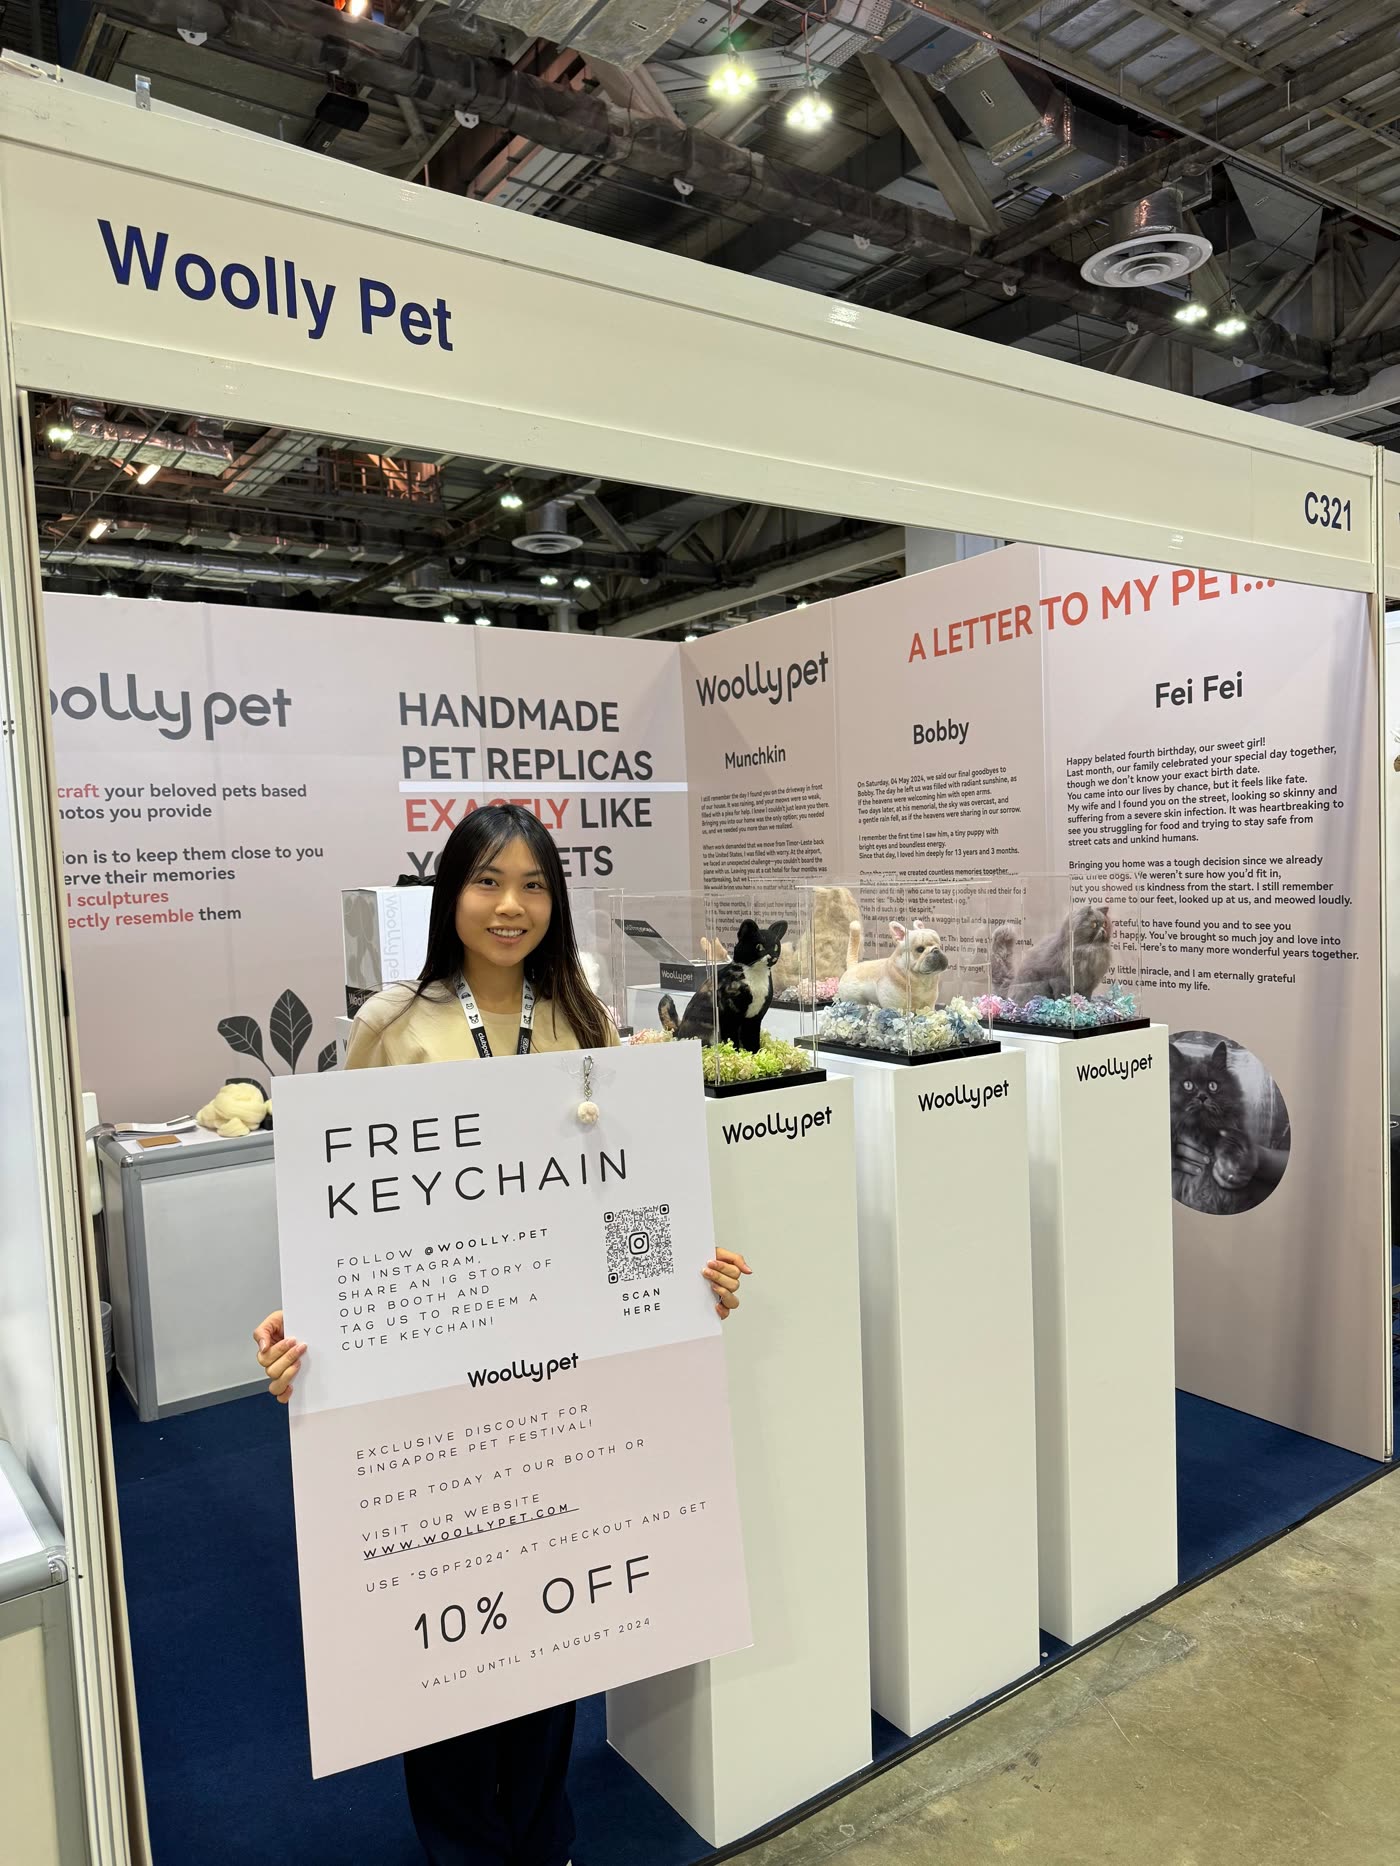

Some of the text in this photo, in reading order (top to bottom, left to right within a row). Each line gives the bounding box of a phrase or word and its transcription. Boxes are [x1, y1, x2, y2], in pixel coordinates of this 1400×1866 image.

[97, 218, 453, 351] Woolly Pet
[1305, 492, 1351, 531] C321
[908, 633, 926, 663] A
[934, 604, 1033, 657] LETTER
[1040, 591, 1088, 630] TO
[1102, 574, 1159, 620] MY
[1155, 671, 1242, 709] Fei Fei
[399, 692, 619, 732] HANDMADE
[913, 719, 969, 745] Bobby
[402, 746, 653, 780] PET REPLICAS
[725, 745, 786, 769] Munchkin
[1066, 737, 1265, 767] Happy belated fourth birthday, our sweet girl!
[1067, 745, 1336, 777] Last month, our family celebrated your special day together,
[104, 786, 144, 801] your
[150, 784, 216, 798] beloved
[222, 785, 256, 800] pets
[261, 784, 306, 797] based
[866, 778, 890, 788] Saturday,
[899, 777, 909, 785] May
[911, 775, 925, 783] 2024,
[936, 772, 946, 780] said
[948, 772, 957, 780] our
[972, 767, 999, 777] goodbyes
[110, 806, 141, 822] you
[148, 804, 212, 821] provide
[580, 798, 652, 828] LIKE
[93, 850, 107, 863] is
[113, 850, 131, 863] to
[137, 848, 178, 865] keep
[183, 847, 226, 861] them
[231, 846, 270, 860] close
[276, 847, 291, 858] to
[296, 847, 323, 861] you
[1069, 861, 1102, 870] Bringing
[1105, 861, 1120, 870] you
[1122, 860, 1145, 868] home
[1174, 858, 1200, 868] tough
[1203, 857, 1240, 866] decision
[1243, 856, 1266, 865] since
[1286, 855, 1323, 866] already
[105, 869, 147, 884] their
[153, 867, 235, 882] memories
[77, 890, 169, 907] sculptures
[116, 909, 194, 926] resemble
[199, 907, 241, 921] them
[325, 1113, 482, 1163] FREE
[326, 1148, 627, 1219] KEYCHAIN
[336, 1228, 549, 1268] FOLLOW @WOOLLY.PET
[337, 1274, 360, 1285] ON
[338, 1258, 554, 1301] SHARE AN IG STORY OF
[623, 1288, 661, 1302] SCAN
[340, 1285, 490, 1317] OUR BOOTH AND
[341, 1292, 538, 1334] TAG US TO REDEEM A
[623, 1303, 662, 1316] HERE
[342, 1335, 389, 1350] CUTE
[356, 1404, 589, 1460] EXCLUSIVE DISCOUNT FOR
[357, 1446, 458, 1476] SINGAPORE
[468, 1438, 498, 1453] PET
[360, 1438, 645, 1509] ORDER TODAY AT OUR BOOTH OR
[362, 1493, 541, 1542] VISIT OUR WEBSITE
[363, 1503, 569, 1559] WWW.WOOLLYPET.COM
[366, 1576, 400, 1593] USE
[520, 1542, 538, 1554] AT
[549, 1518, 633, 1548] CHECKOUT
[642, 1510, 670, 1524] AND
[680, 1501, 707, 1516] GET
[414, 1555, 649, 1650] 10% OFF
[422, 1618, 651, 1689] VALID UNTIL 31 AUGUST 2024
